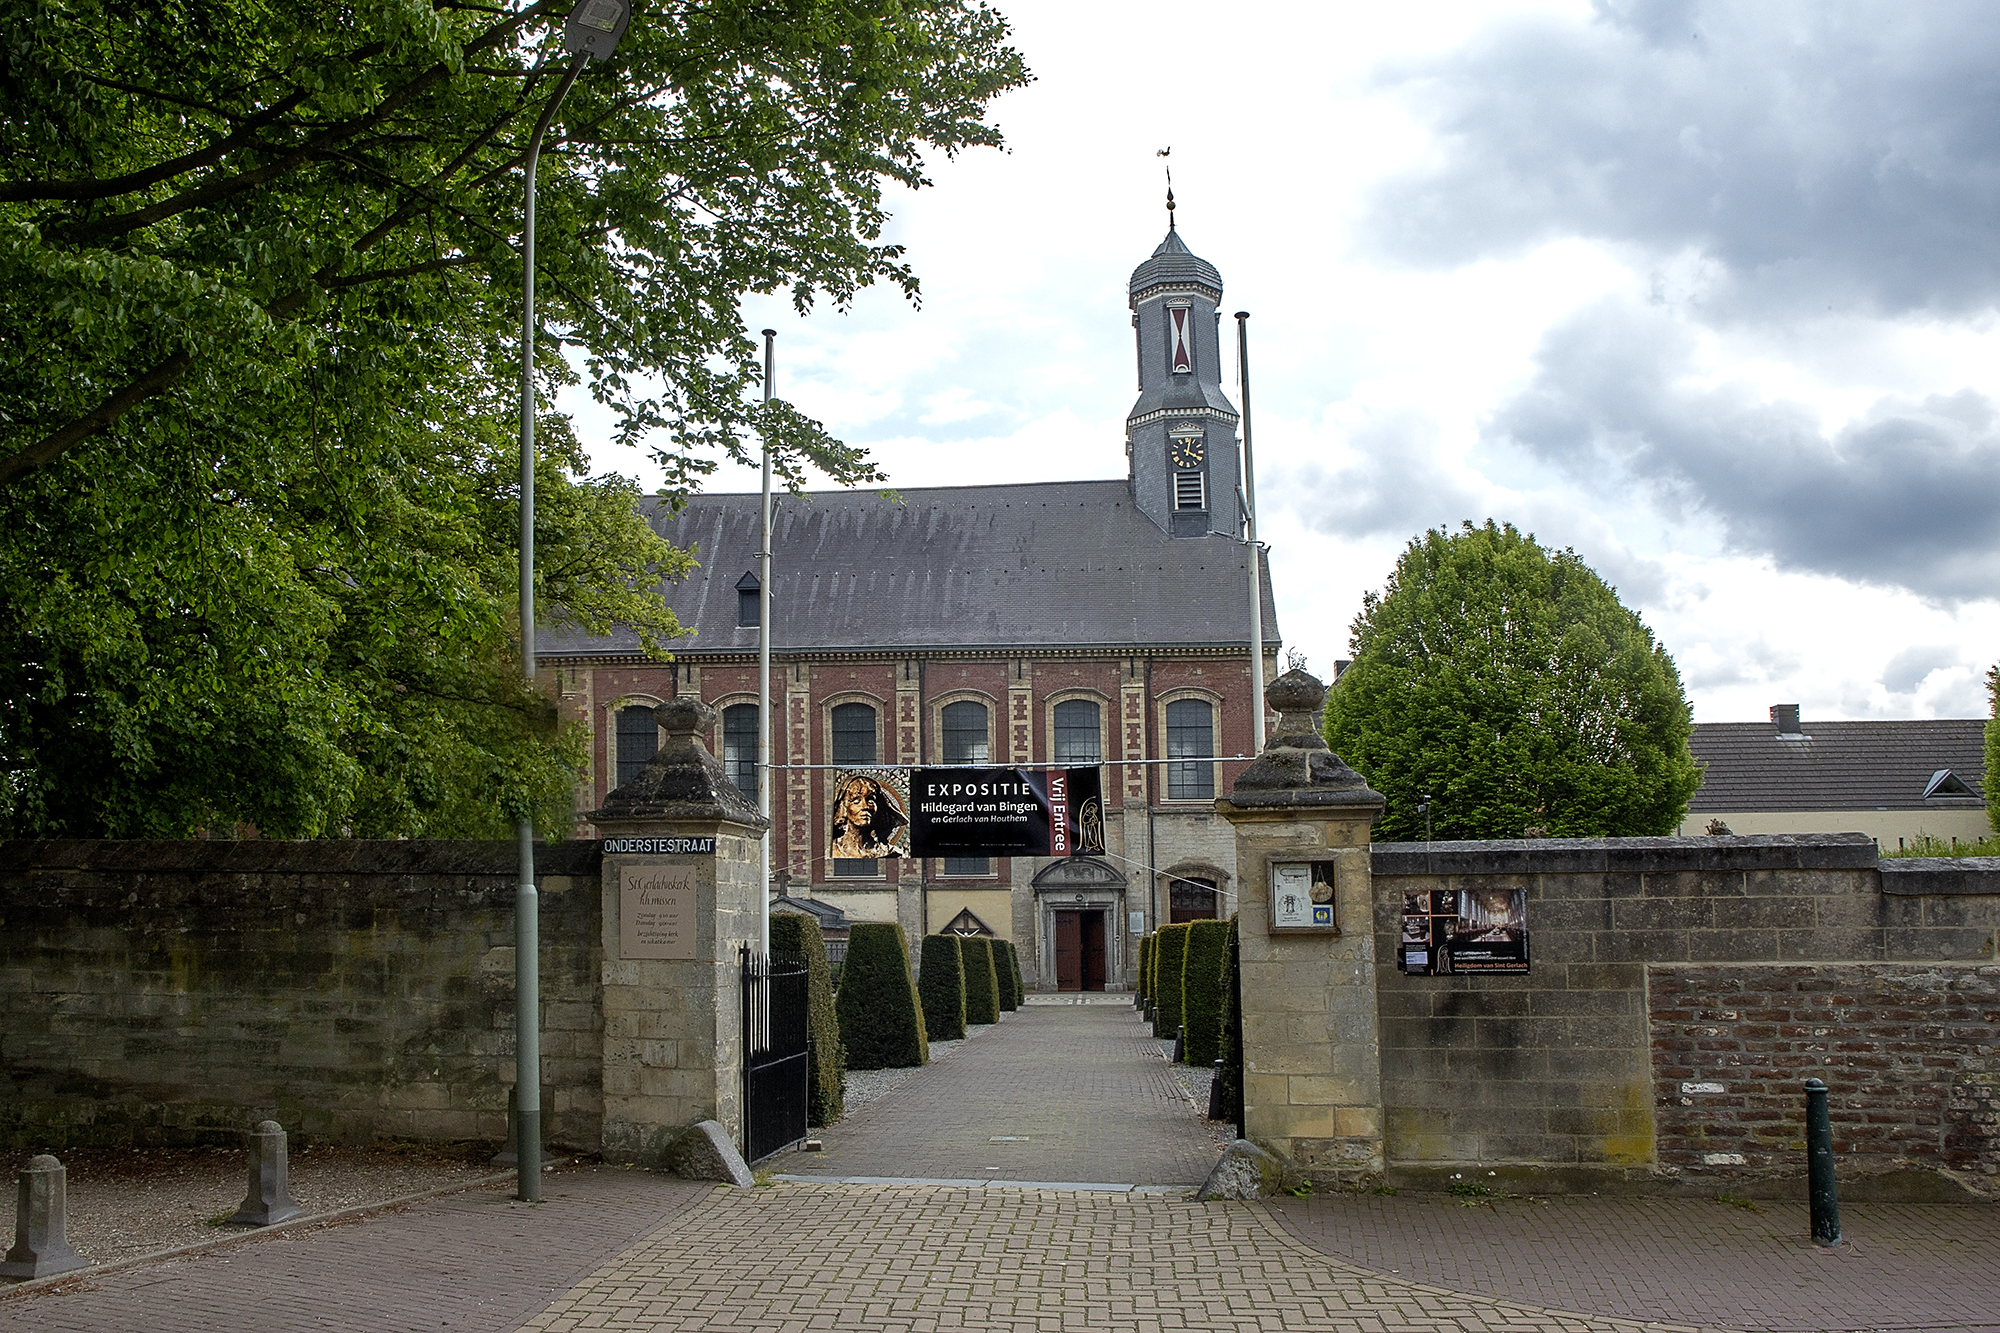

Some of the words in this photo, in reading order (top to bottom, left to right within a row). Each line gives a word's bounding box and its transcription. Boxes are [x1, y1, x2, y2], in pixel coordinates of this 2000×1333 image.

[928, 783, 1031, 797] EXPOSITIE
[1050, 777, 1065, 802] Vrij
[921, 802, 975, 814] Hildegard
[977, 804, 997, 812] van
[999, 801, 1038, 814] Bingen
[942, 815, 973, 823] Gerlach
[991, 814, 1028, 823] Houthem
[1053, 805, 1066, 852] Entree
[604, 839, 713, 852] ONDERSTESTRAAT
[651, 896, 677, 906] missen
